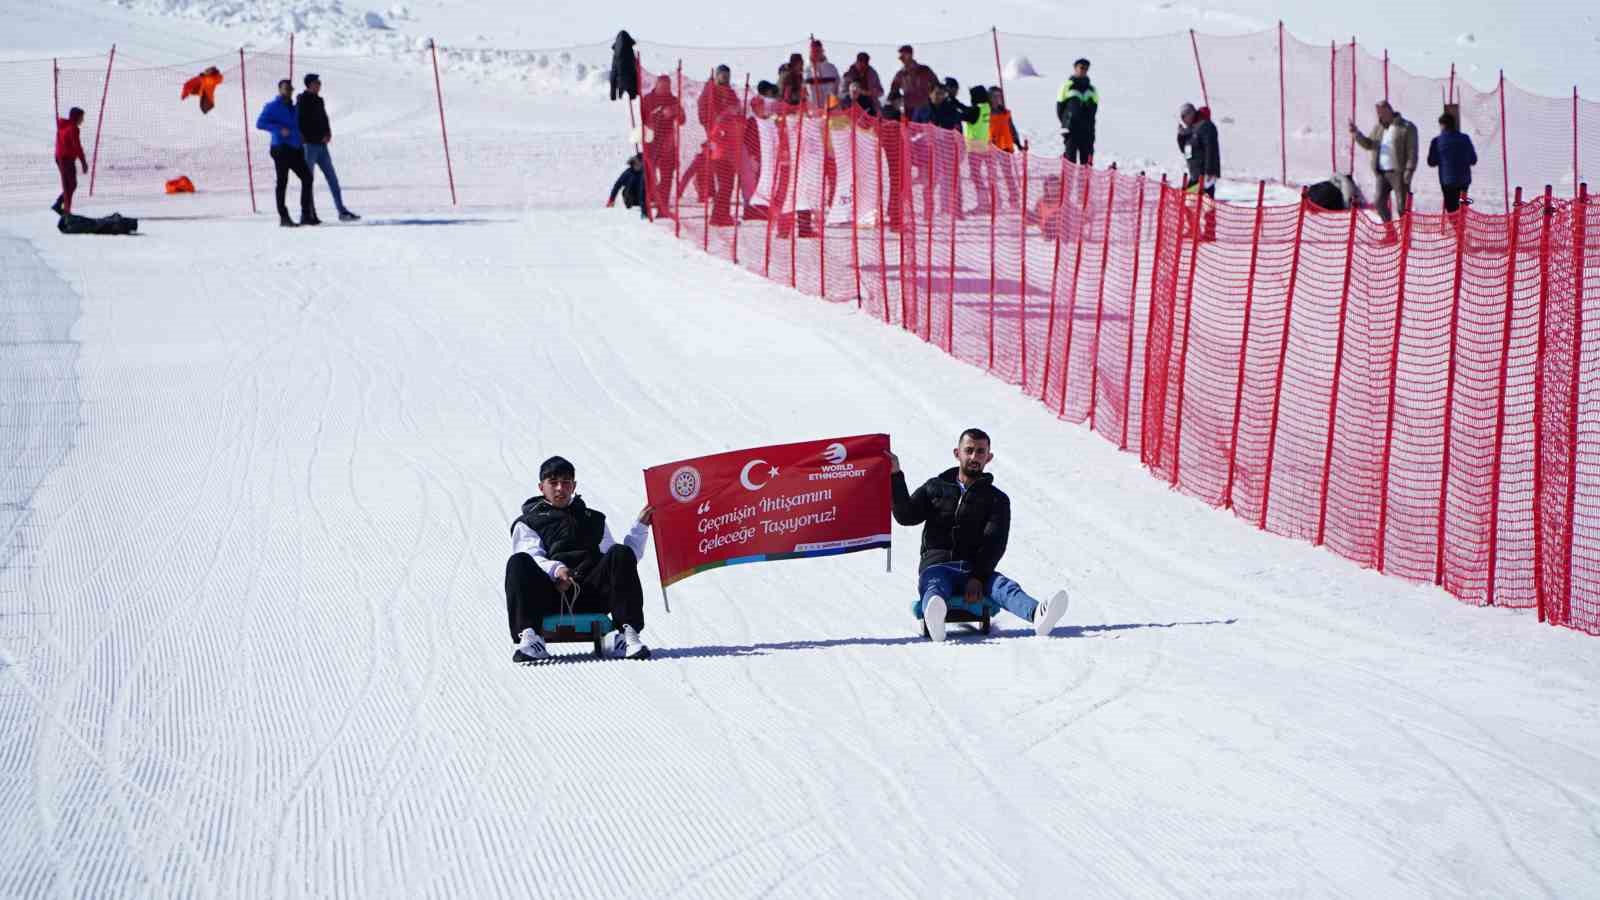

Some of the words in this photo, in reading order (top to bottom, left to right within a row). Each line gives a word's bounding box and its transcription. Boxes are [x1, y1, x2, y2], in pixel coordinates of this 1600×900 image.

[808, 469, 866, 480] ETHNOSPORT
[821, 463, 854, 473] WORLD
[698, 504, 756, 534] Geçmişin
[759, 488, 832, 513] İhtişamını
[698, 526, 756, 555] Geleceğe
[760, 505, 837, 536] Taşıyoruz!
